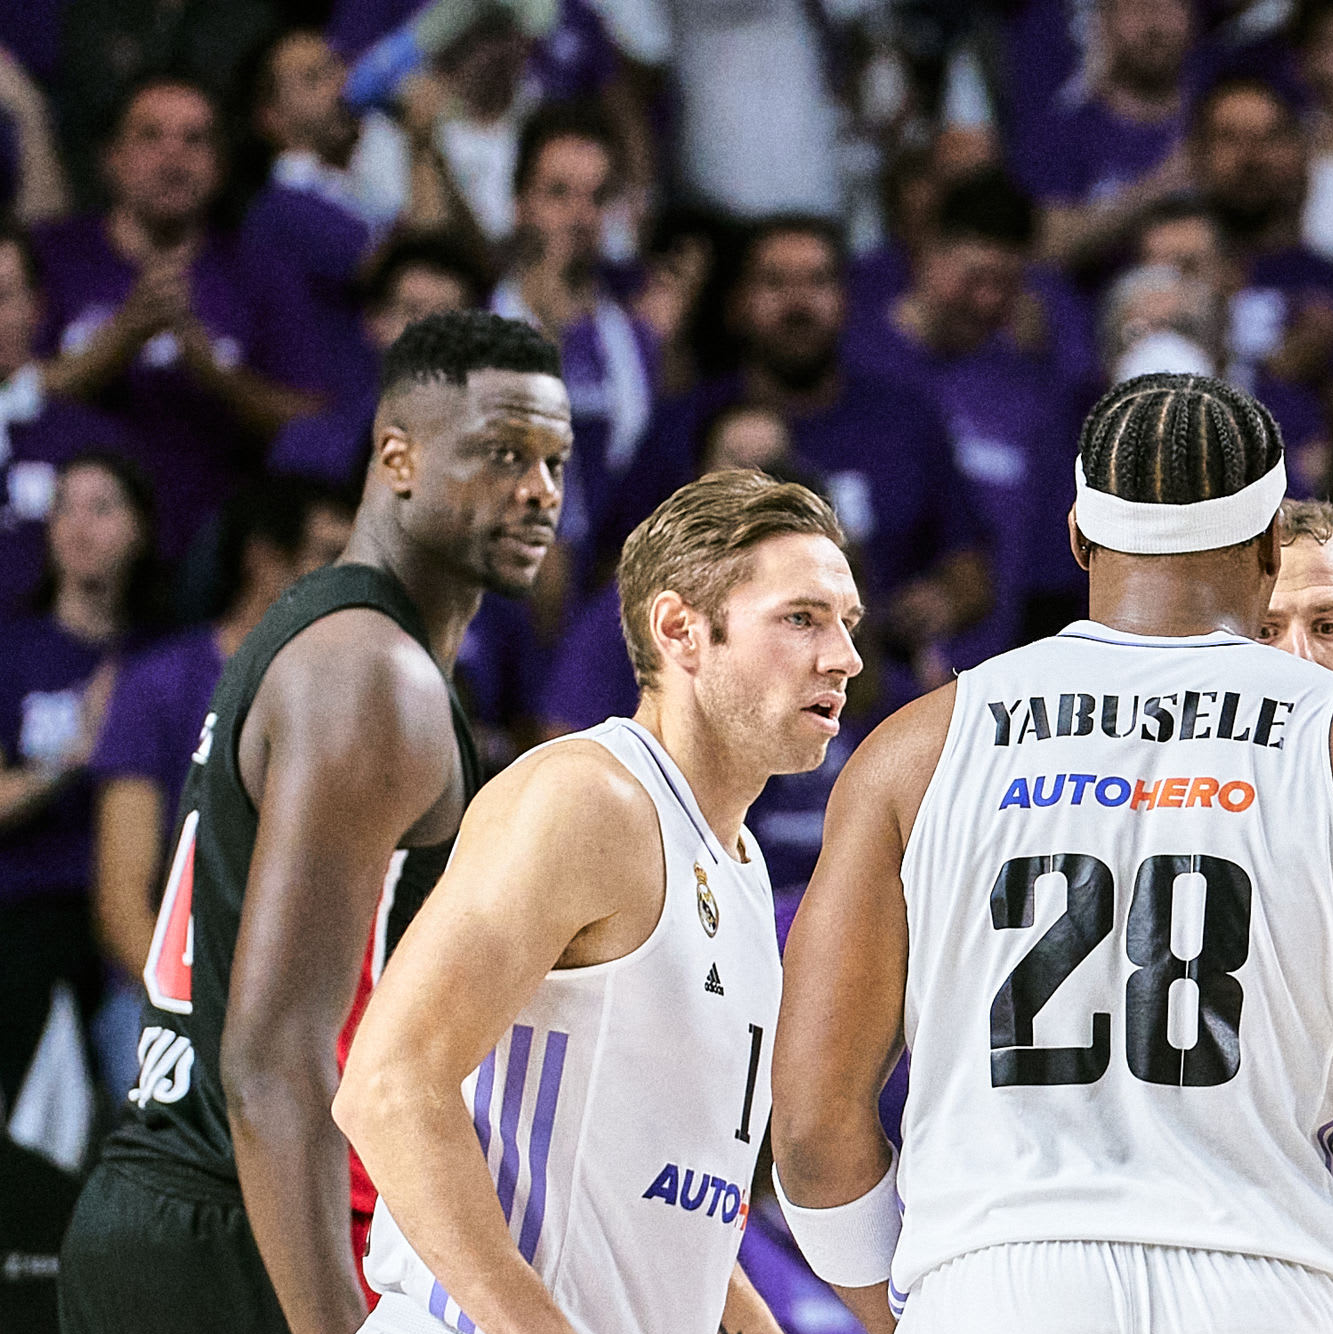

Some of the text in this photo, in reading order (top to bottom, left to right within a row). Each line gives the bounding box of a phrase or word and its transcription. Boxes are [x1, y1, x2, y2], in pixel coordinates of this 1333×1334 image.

[987, 690, 1295, 750] YABUSELE
[998, 773, 1256, 813] AUTOHERO
[989, 852, 1253, 1088] 28
